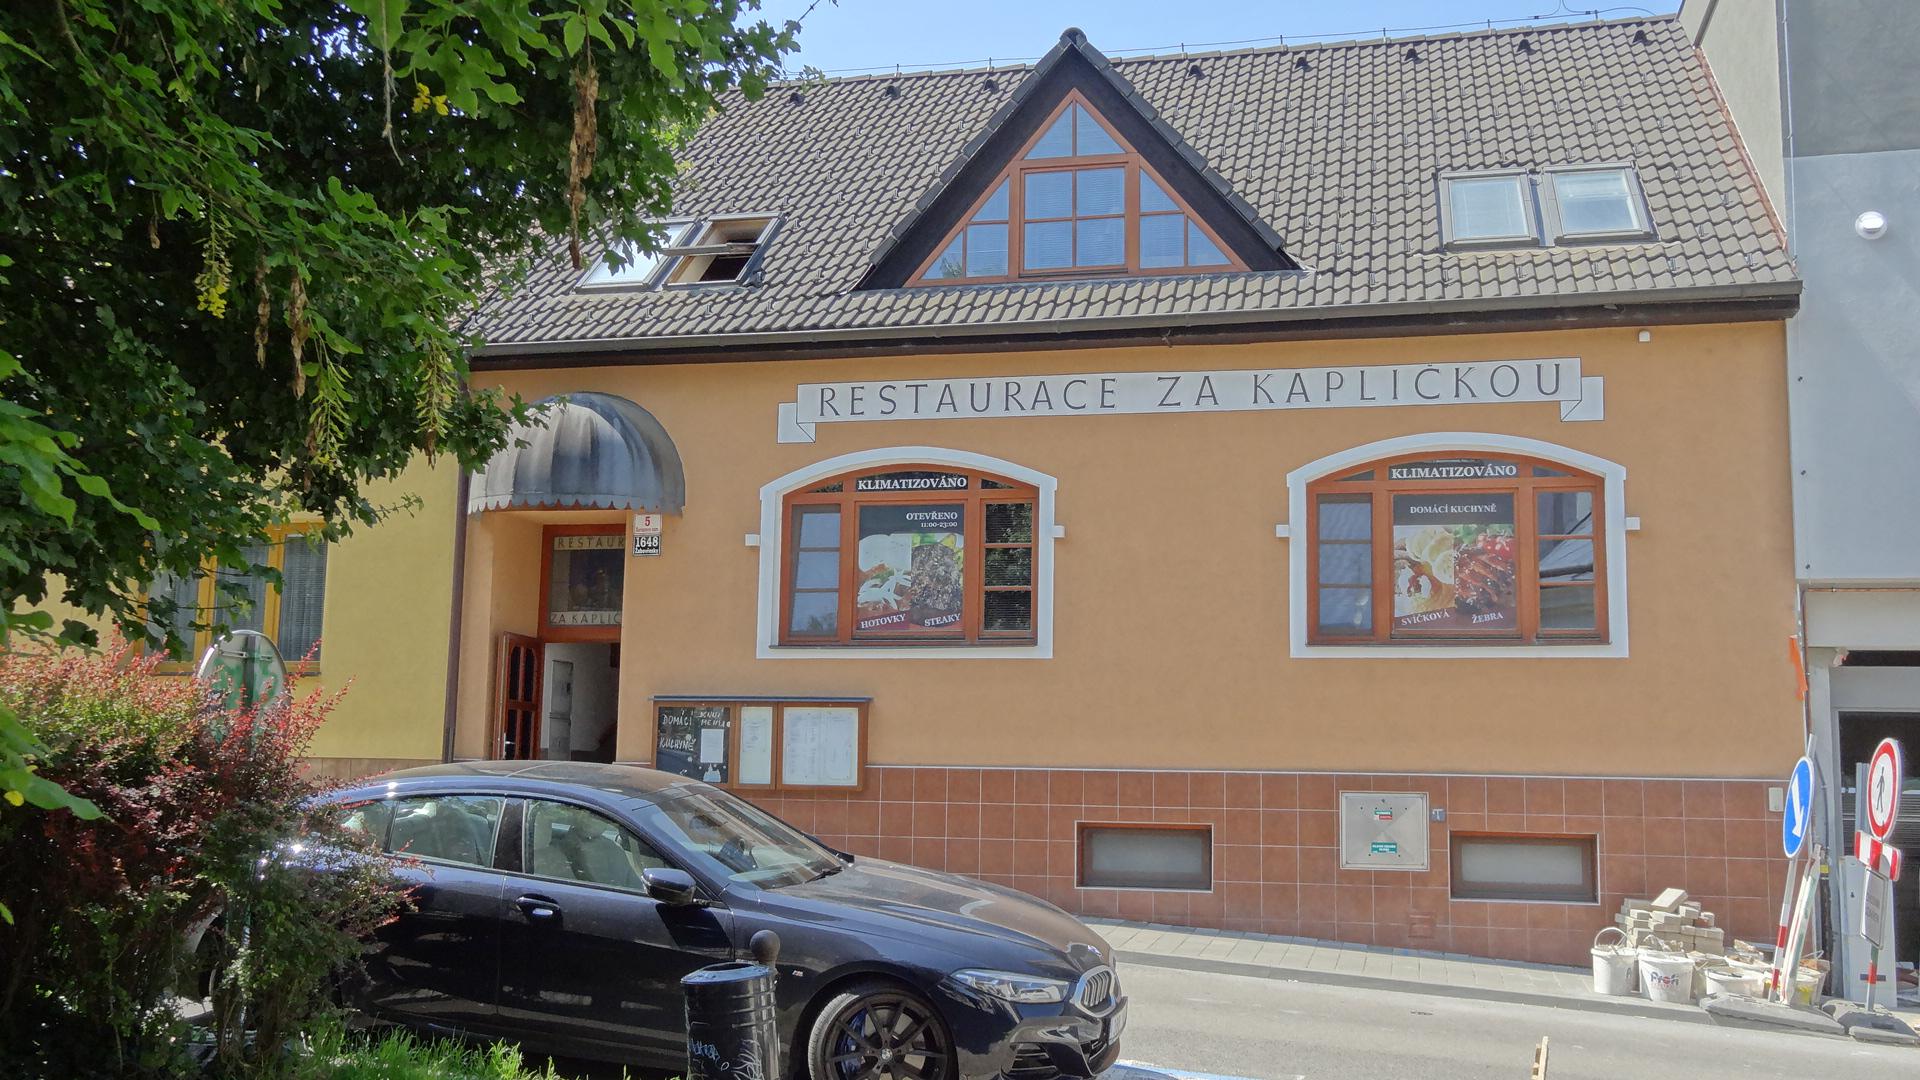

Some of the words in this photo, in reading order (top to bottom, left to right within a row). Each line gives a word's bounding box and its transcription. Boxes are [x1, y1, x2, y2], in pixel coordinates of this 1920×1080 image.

[819, 378, 1117, 416] RESTAURACE
[1157, 375, 1219, 407] ZA
[1252, 363, 1560, 404] KAPLIČKOU
[1391, 464, 1517, 479] KLIMATIZOVÁNO
[858, 476, 967, 490] KLIMATIZOVÁNO
[1410, 503, 1448, 514] DOMÁCÍ
[1450, 502, 1497, 514] KUCHYNĚ
[645, 516, 651, 527] 5
[906, 511, 958, 520] OTEVŘENO
[635, 536, 659, 548] 1648
[551, 613, 566, 624] ZA
[860, 613, 906, 628] HOTOVKY
[924, 613, 961, 627] STEAKY
[1471, 611, 1504, 624] ŽEBRA
